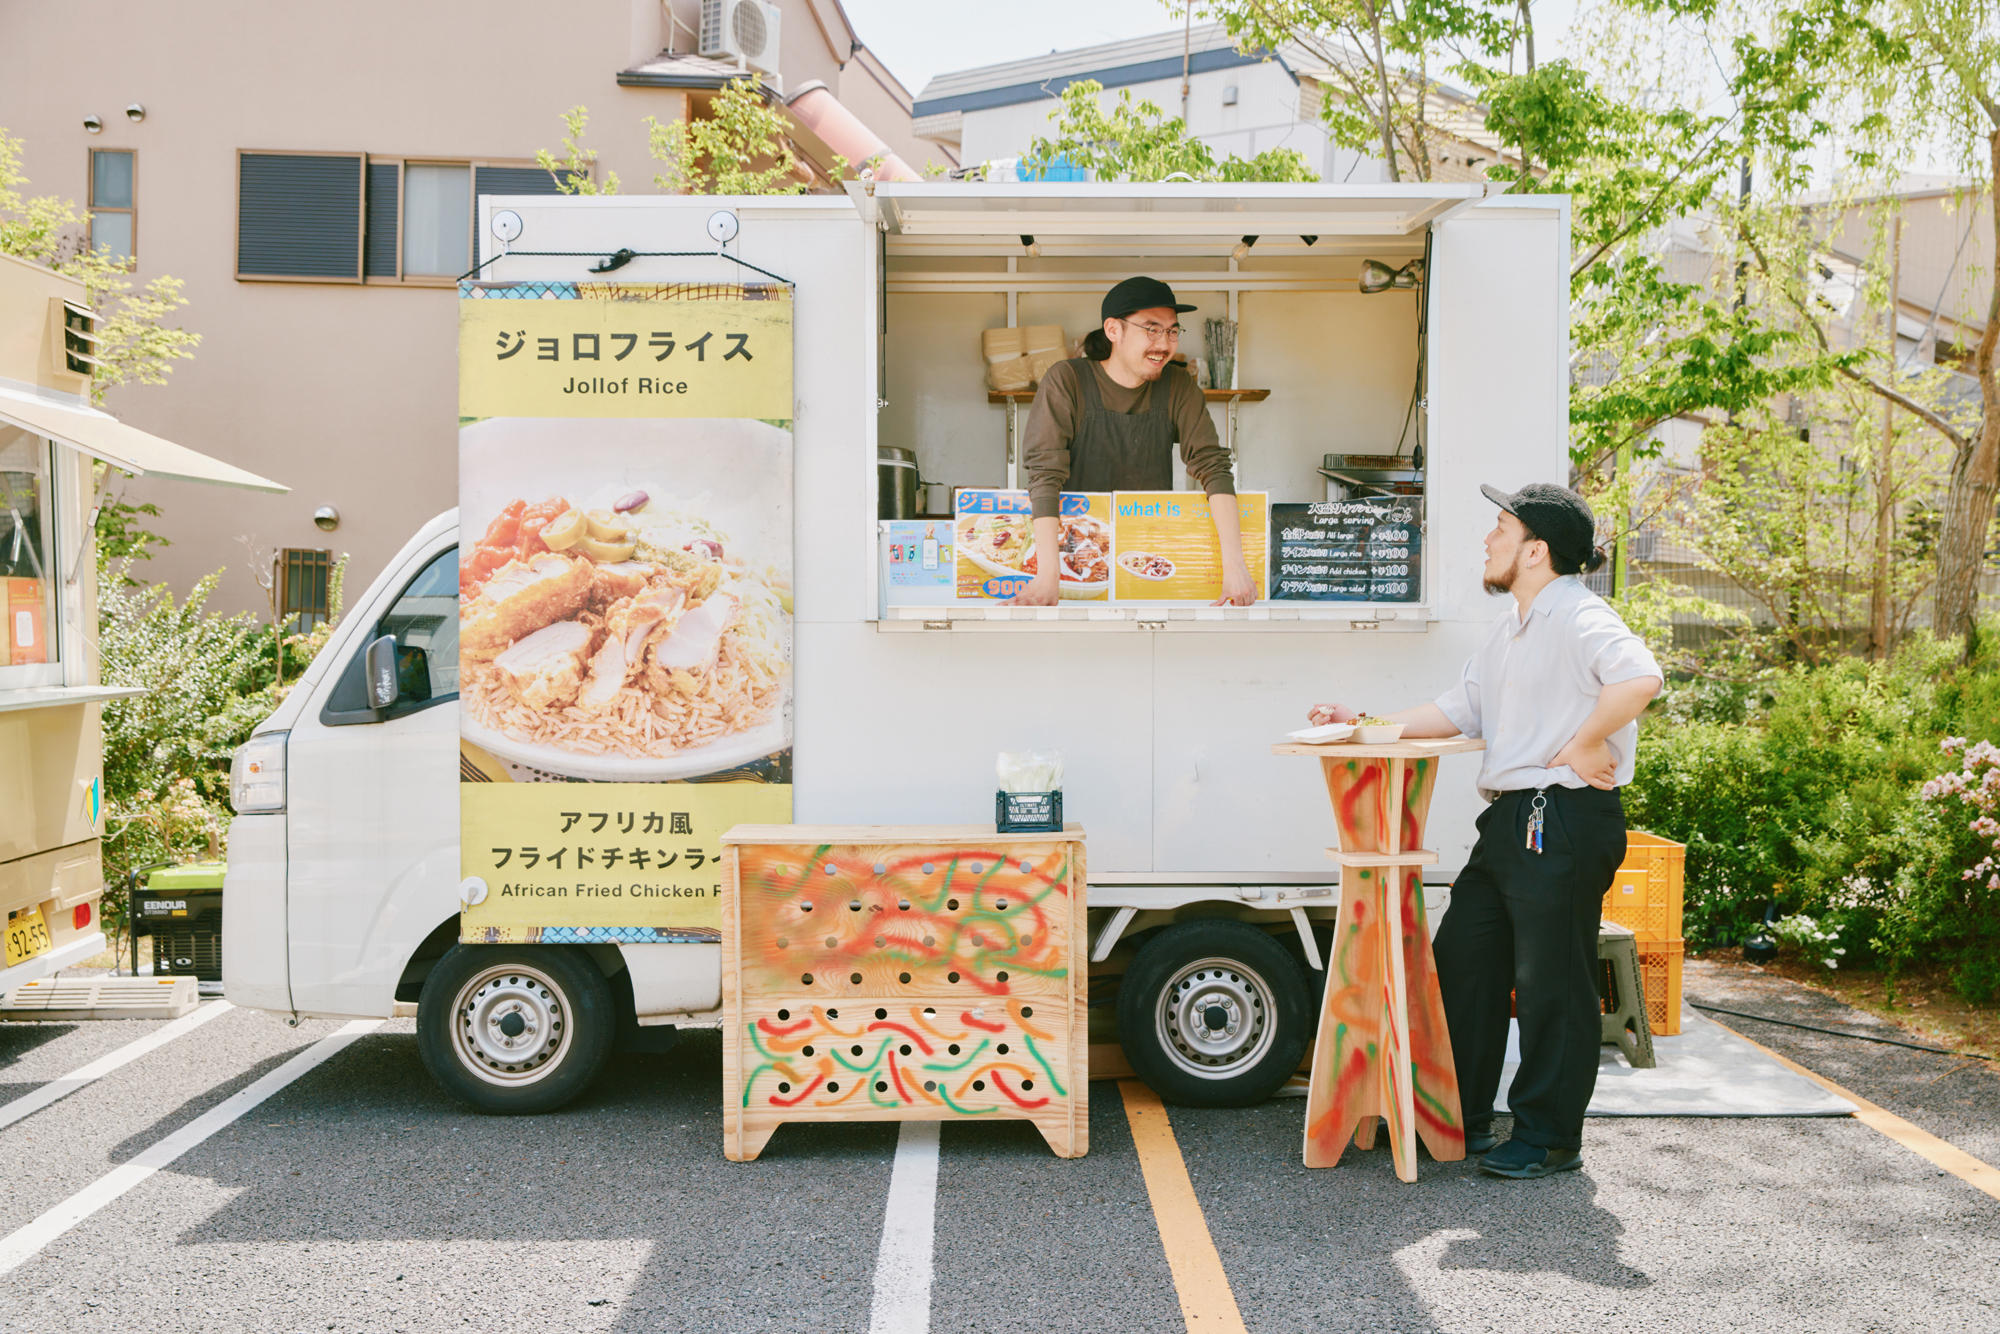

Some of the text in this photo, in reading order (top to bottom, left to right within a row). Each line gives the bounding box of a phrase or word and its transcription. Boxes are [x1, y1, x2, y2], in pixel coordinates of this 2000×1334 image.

[496, 330, 754, 362] ジョロフライス
[563, 377, 688, 395] Jollof Rice
[1118, 501, 1181, 517] what is
[1314, 515, 1375, 526] Large serving
[1338, 531, 1354, 540] large
[1282, 547, 1328, 558] ライス大盛り
[1329, 549, 1348, 558] Large
[1281, 565, 1328, 576] チキン大盛り
[1343, 567, 1367, 576] chicken
[1281, 581, 1328, 593] サラダ大盛り
[1328, 585, 1347, 593] Large
[1348, 583, 1366, 593] salad
[559, 811, 694, 836] アフリカ風
[501, 883, 568, 899] African
[575, 883, 623, 898] Fried
[629, 883, 706, 898] Chicken
[144, 900, 187, 910] EENOUR
